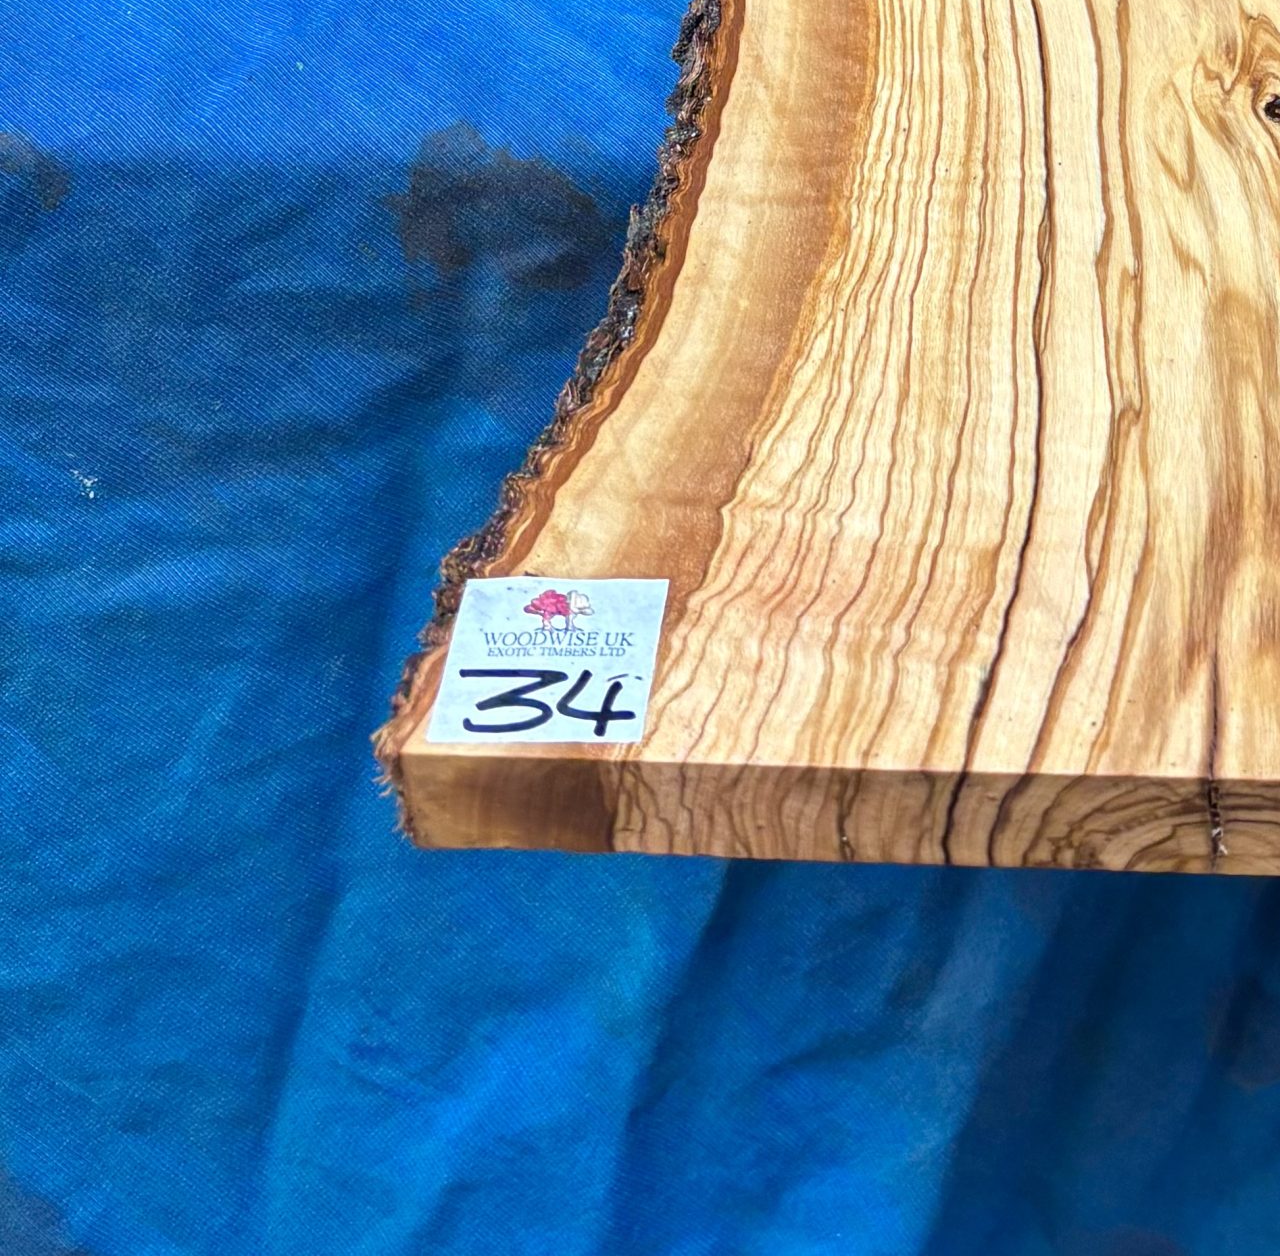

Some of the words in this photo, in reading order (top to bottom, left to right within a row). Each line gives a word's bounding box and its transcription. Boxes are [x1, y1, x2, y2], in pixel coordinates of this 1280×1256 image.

[483, 631, 599, 647] WOODWISE
[604, 631, 635, 647] UK
[487, 646, 536, 657] EXOTIC
[539, 646, 597, 657] TIMBERS
[599, 646, 627, 657] LTD
[459, 668, 636, 737] 34
